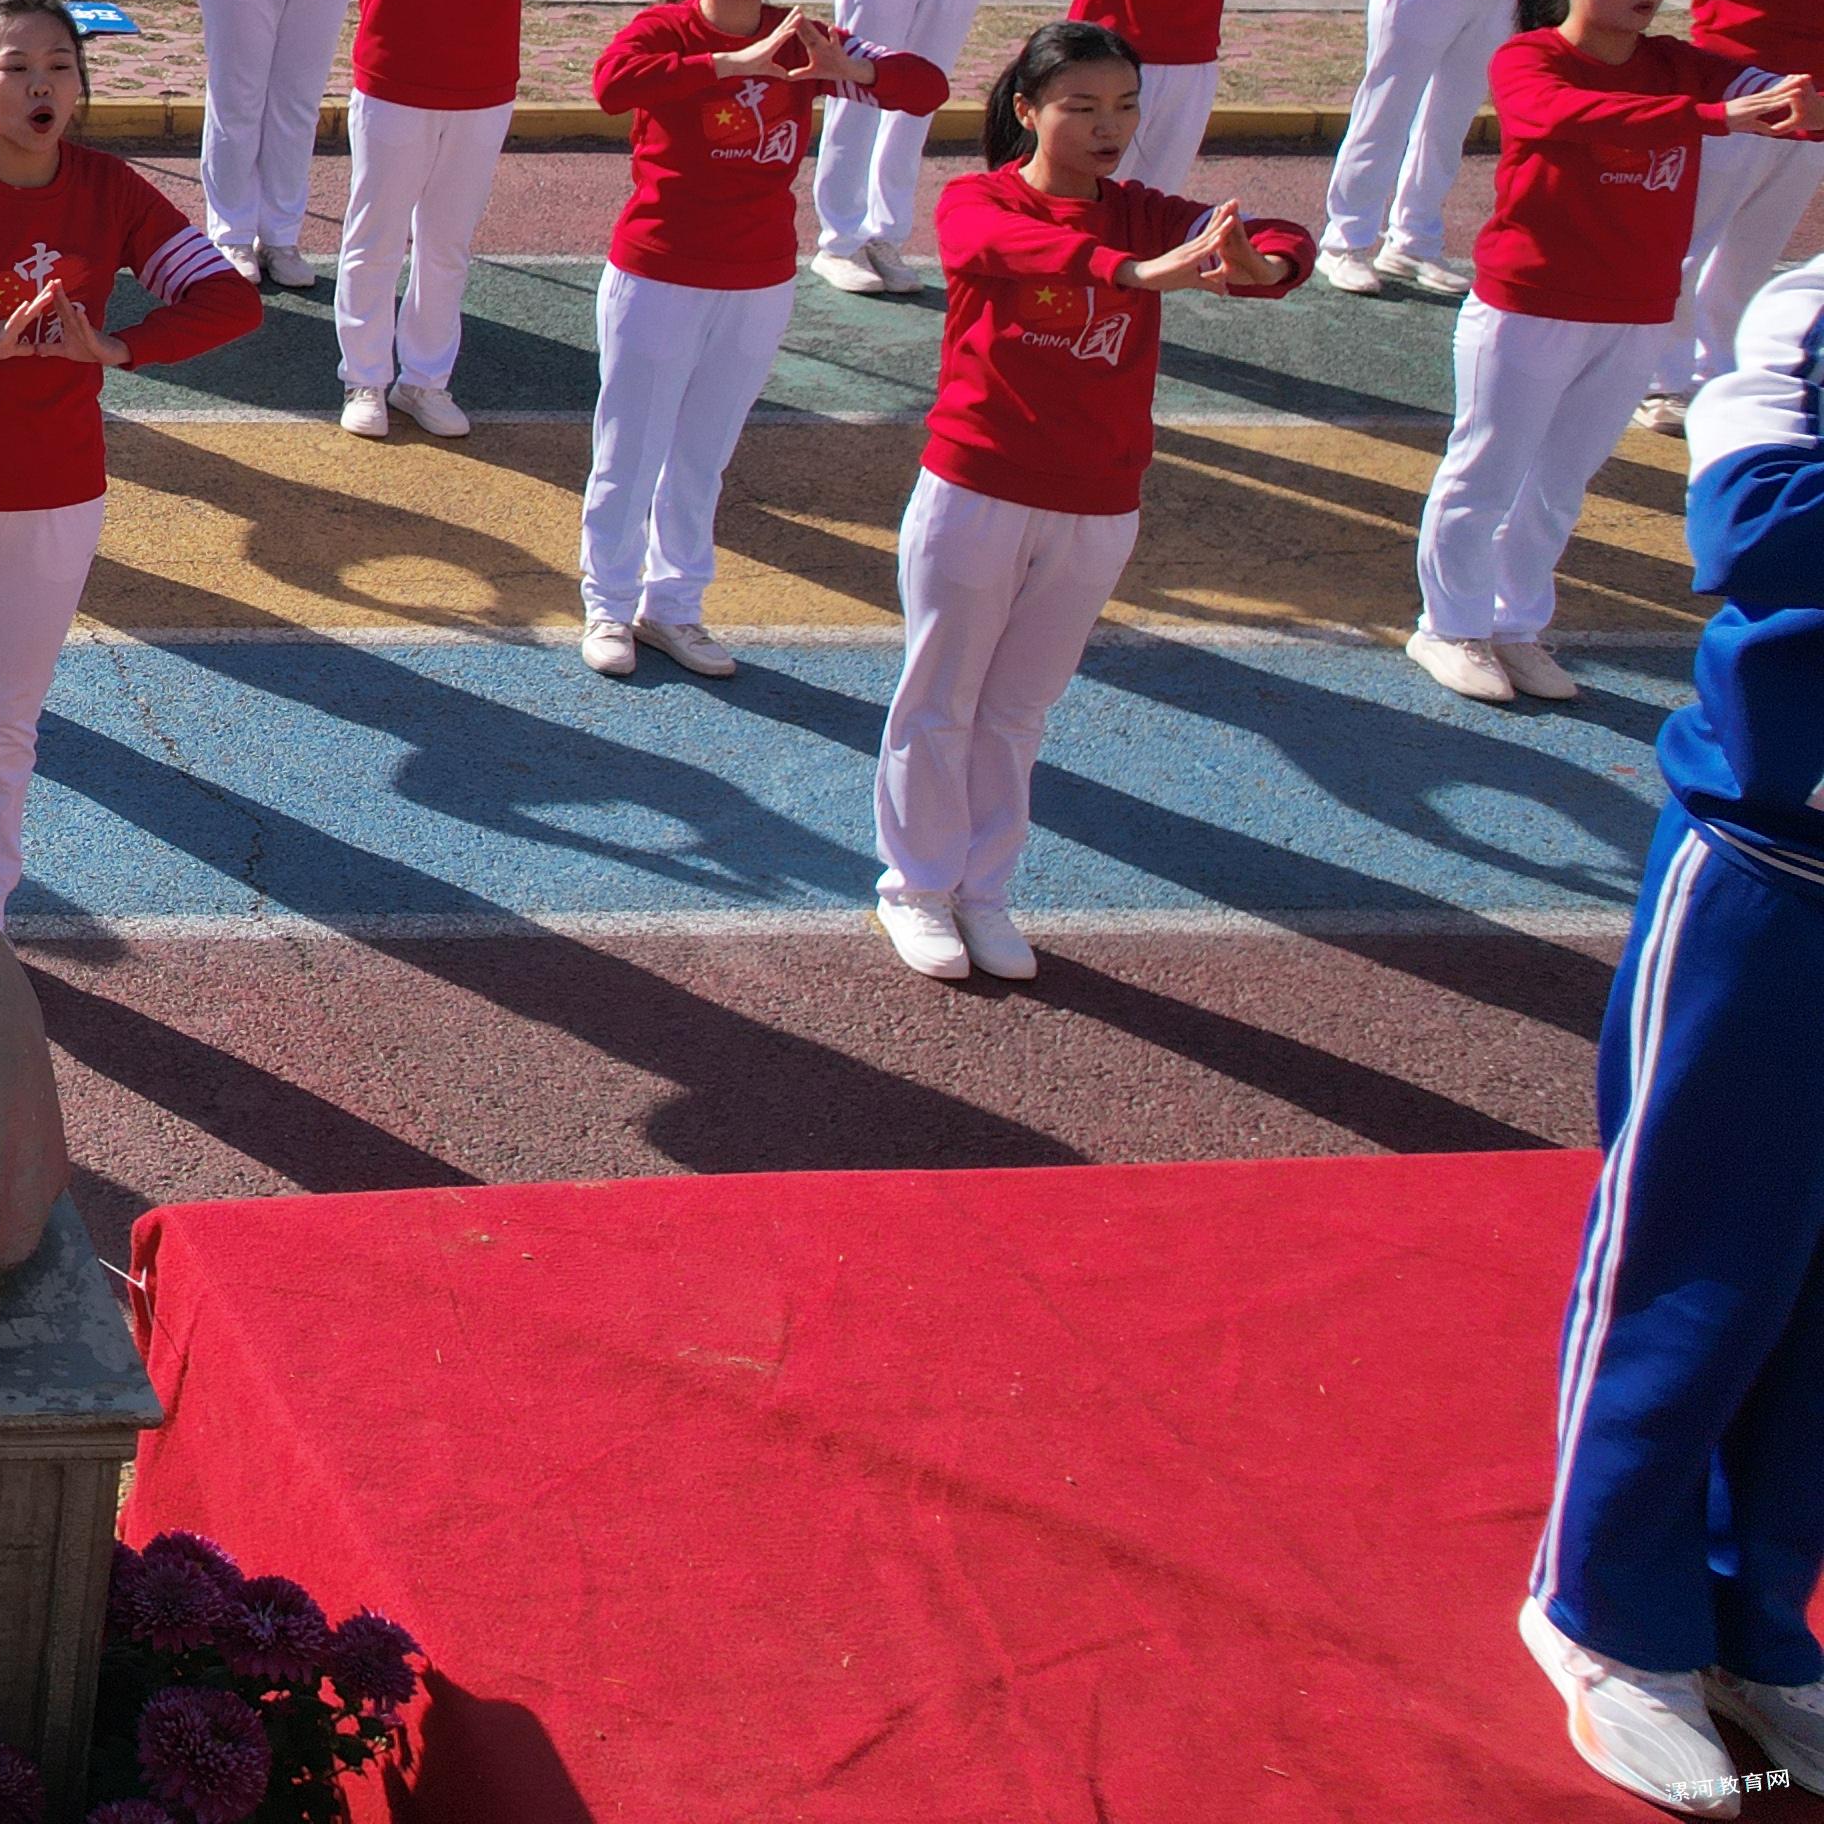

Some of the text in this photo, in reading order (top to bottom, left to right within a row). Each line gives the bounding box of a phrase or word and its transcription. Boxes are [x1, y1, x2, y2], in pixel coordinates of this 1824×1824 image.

[711, 149, 752, 159] CHINA
[1600, 172, 1644, 185] CHINA
[1022, 331, 1071, 348] CHINA
